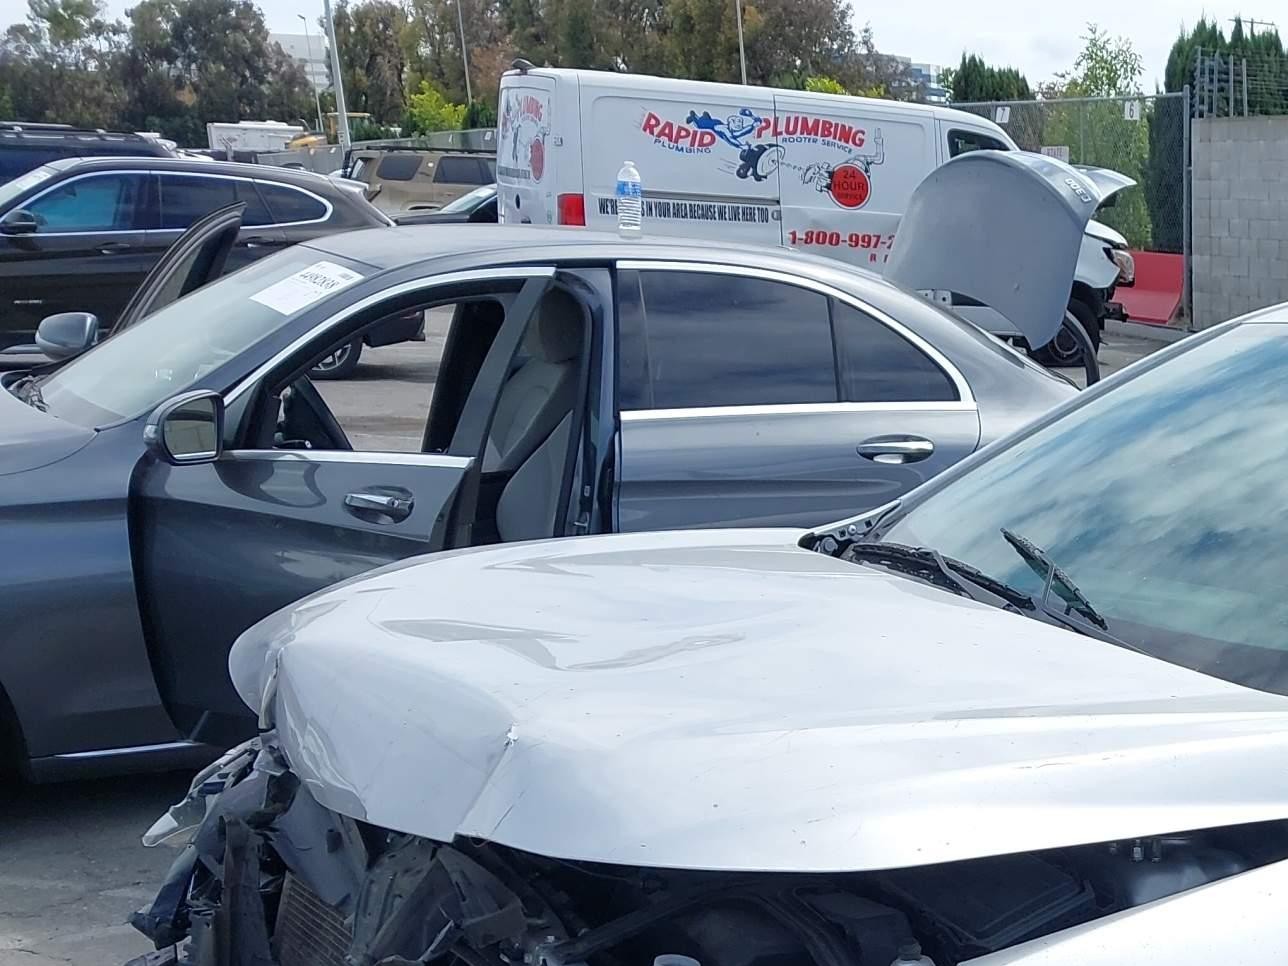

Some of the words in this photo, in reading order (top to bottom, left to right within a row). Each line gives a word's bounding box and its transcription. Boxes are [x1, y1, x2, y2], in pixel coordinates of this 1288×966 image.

[1129, 101, 1134, 118] 6
[642, 112, 716, 148] RAPID
[756, 116, 866, 148] PLUMBING
[653, 138, 712, 154] PLUMBING
[782, 136, 817, 144] ROOTER
[821, 139, 853, 154] SERVICE
[843, 170, 857, 179] 24
[834, 181, 865, 191] HOUR
[646, 201, 653, 217] IN
[654, 201, 672, 218] YOUR
[672, 202, 688, 219] AREA
[689, 203, 717, 221] BECAUSE
[717, 204, 728, 221] WE
[728, 205, 741, 222] LIVE
[741, 206, 756, 223] HERE
[757, 207, 769, 223] TOO
